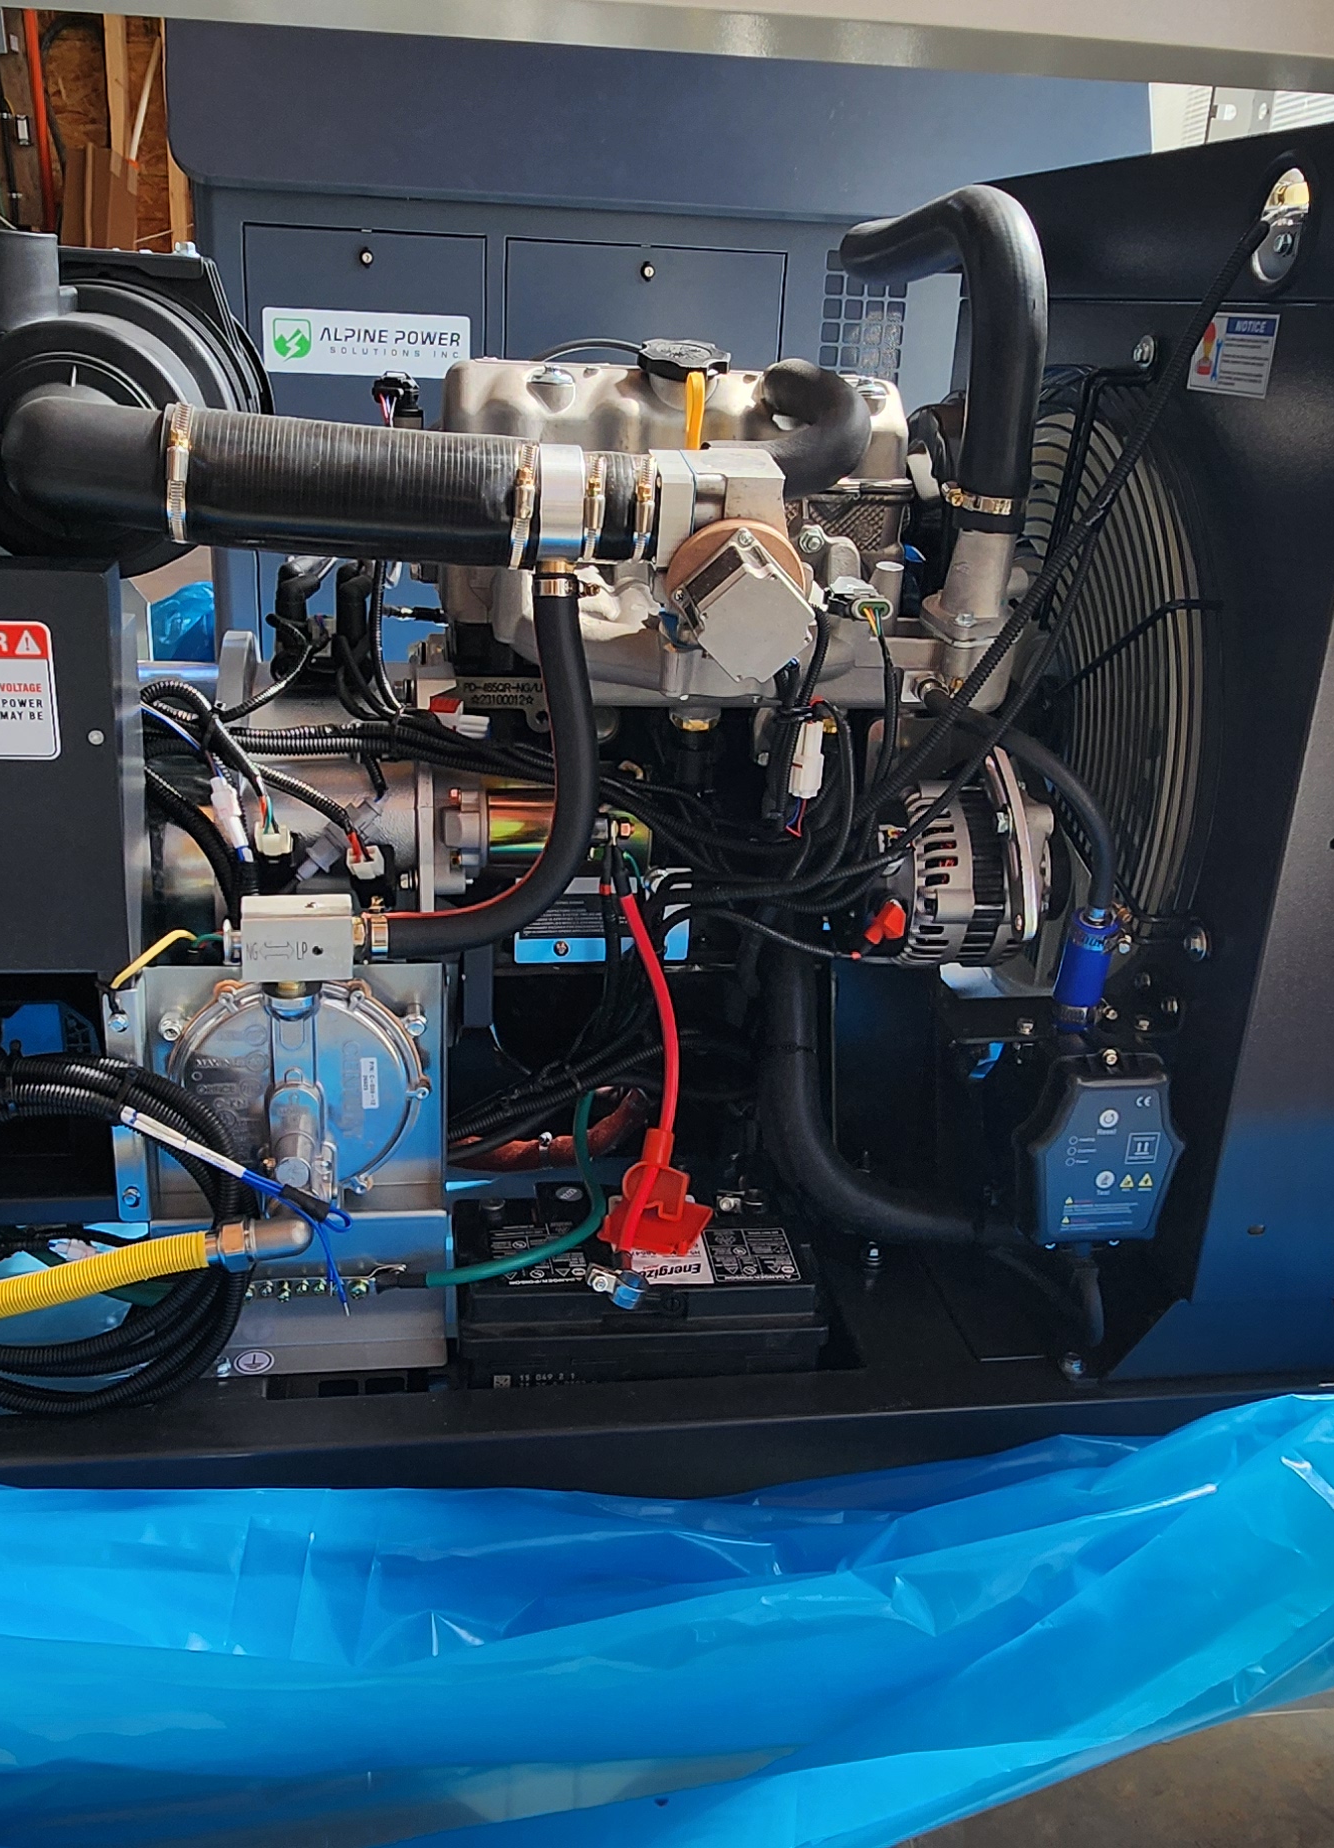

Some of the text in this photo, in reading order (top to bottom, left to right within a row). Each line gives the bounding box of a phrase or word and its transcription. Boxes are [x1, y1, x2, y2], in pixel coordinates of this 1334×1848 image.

[1234, 320, 1267, 333] NOTICE
[319, 327, 461, 347] ALPINE POWER
[329, 346, 461, 359] SOLUTIONS INC.
[1, 699, 44, 709] POWER
[0, 711, 24, 721] MAY
[29, 711, 44, 720] BE
[296, 941, 308, 960] LP
